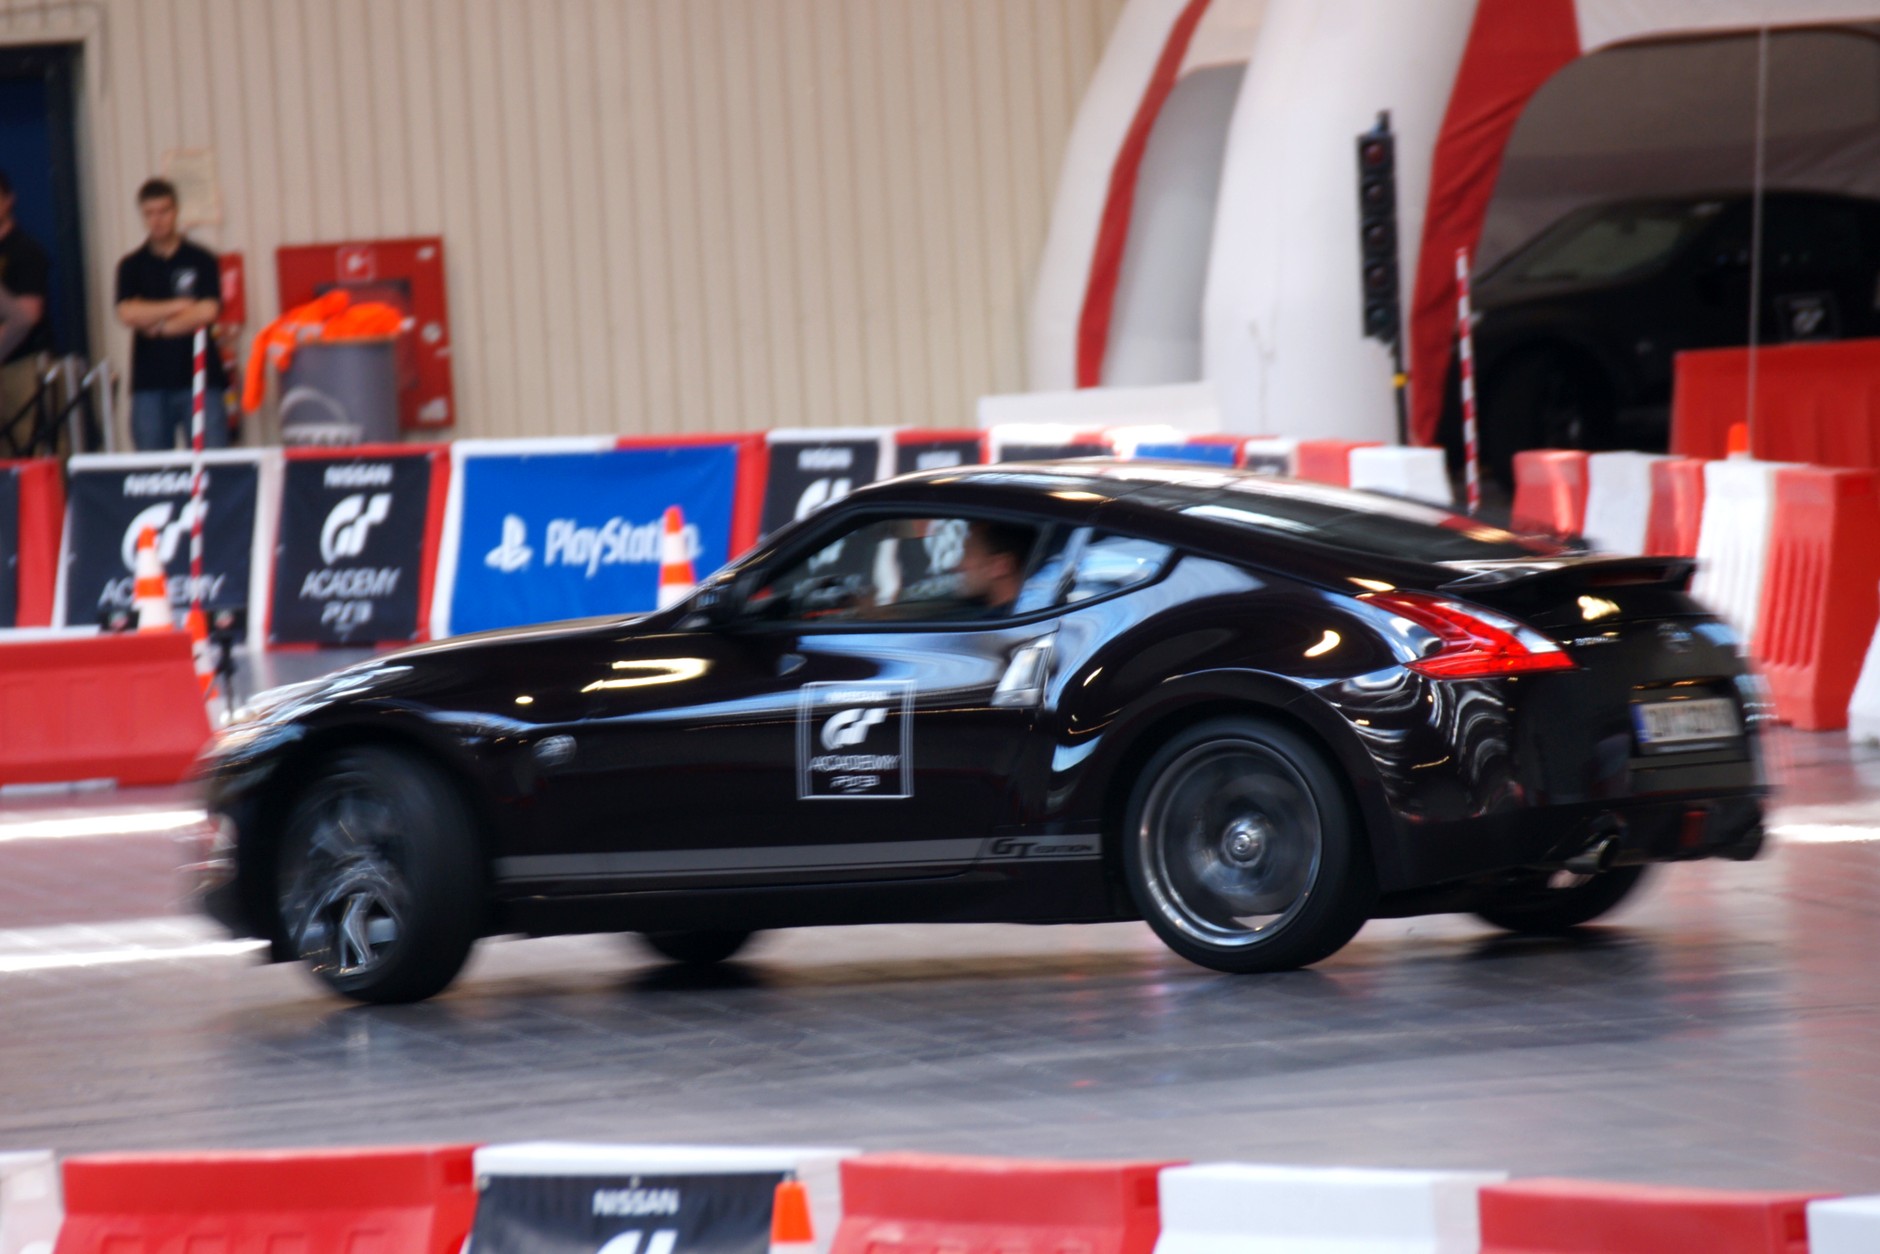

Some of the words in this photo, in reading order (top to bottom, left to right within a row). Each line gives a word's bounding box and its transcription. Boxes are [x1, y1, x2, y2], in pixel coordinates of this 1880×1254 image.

[324, 463, 394, 487] NISSAN
[299, 567, 402, 599] ACADEMY
[592, 1188, 680, 1216] NISSAN
